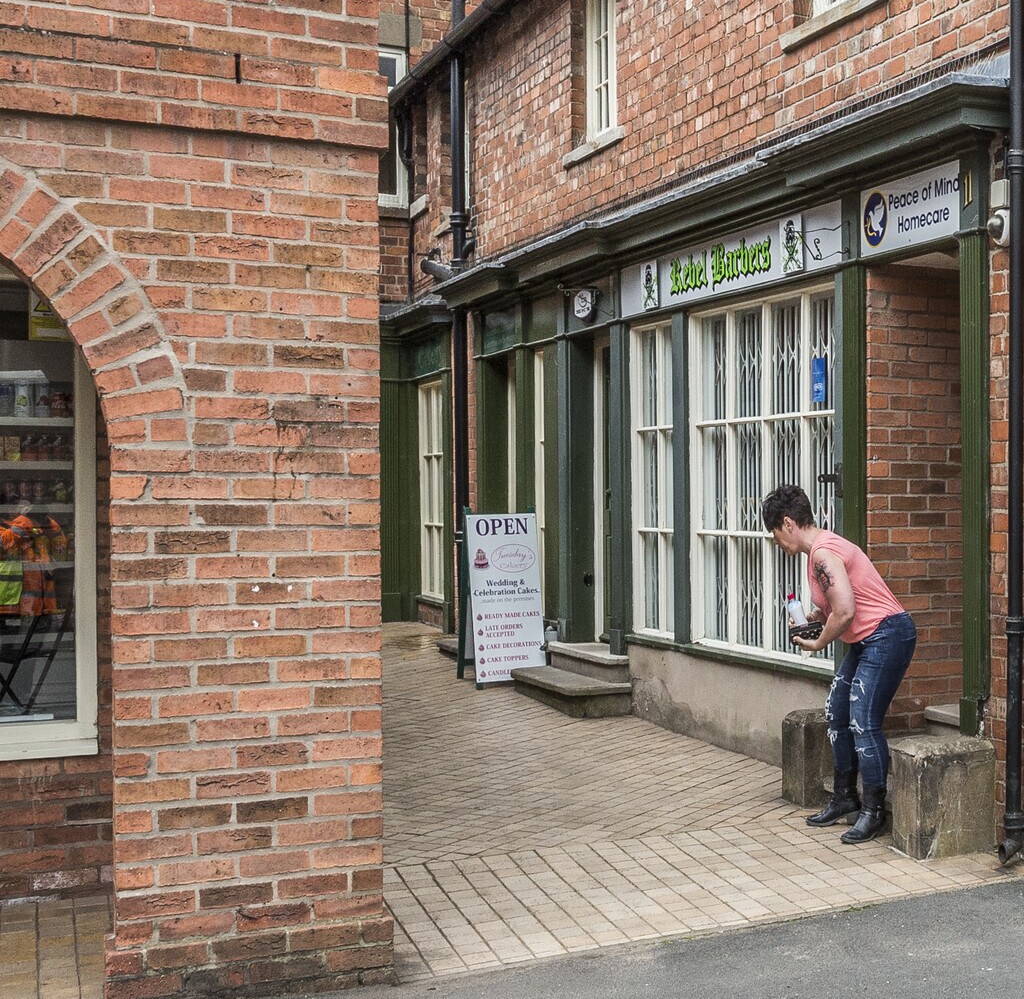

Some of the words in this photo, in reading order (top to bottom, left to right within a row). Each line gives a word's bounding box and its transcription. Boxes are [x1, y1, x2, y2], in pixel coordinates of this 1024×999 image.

[888, 190, 919, 211] Peace
[921, 182, 932, 201] of
[934, 173, 960, 198] Mind
[897, 207, 949, 233] Homecare
[670, 253, 708, 297] Rebel
[711, 235, 771, 292] Barbers
[476, 518, 528, 536] OPEN
[493, 547, 533, 562] Tuesday's
[486, 579, 518, 587] Wedding
